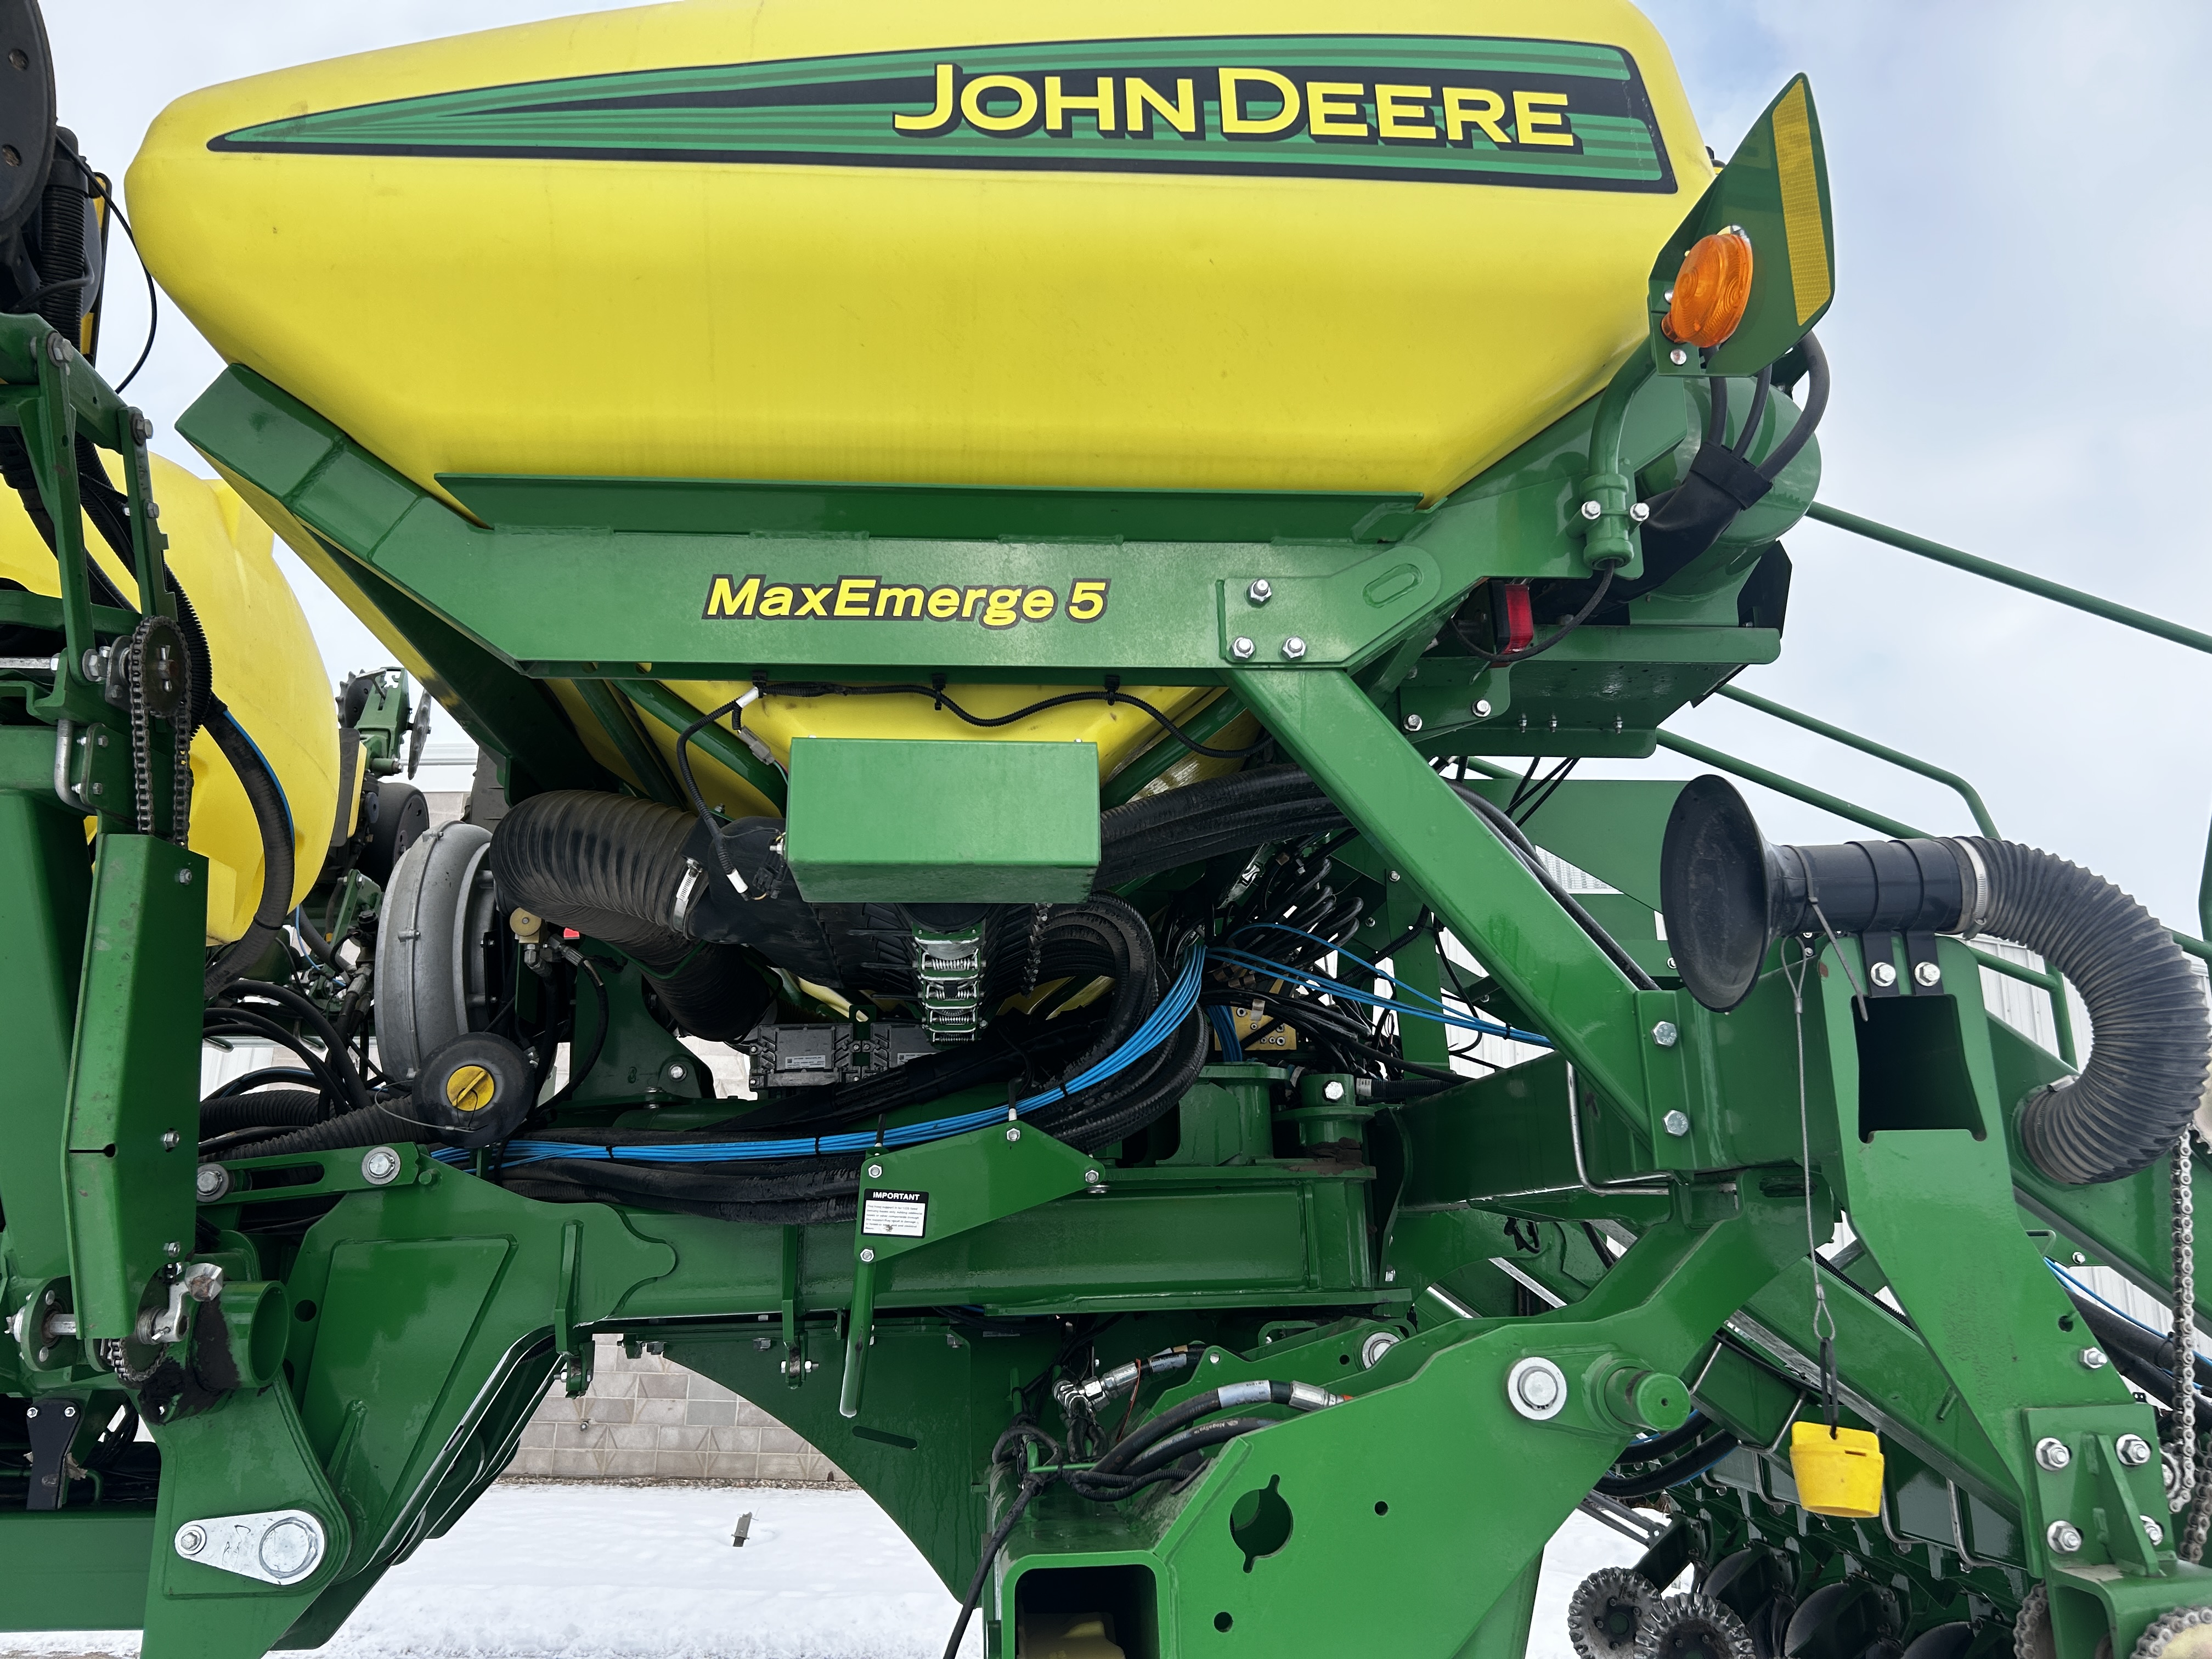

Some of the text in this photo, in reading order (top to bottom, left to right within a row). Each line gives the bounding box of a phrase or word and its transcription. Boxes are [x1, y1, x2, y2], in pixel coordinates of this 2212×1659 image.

[894, 63, 1575, 147] JOHN DEERE
[706, 577, 1107, 626] MaxEmerge 5
[872, 1191, 921, 1201] IMPORTANT
